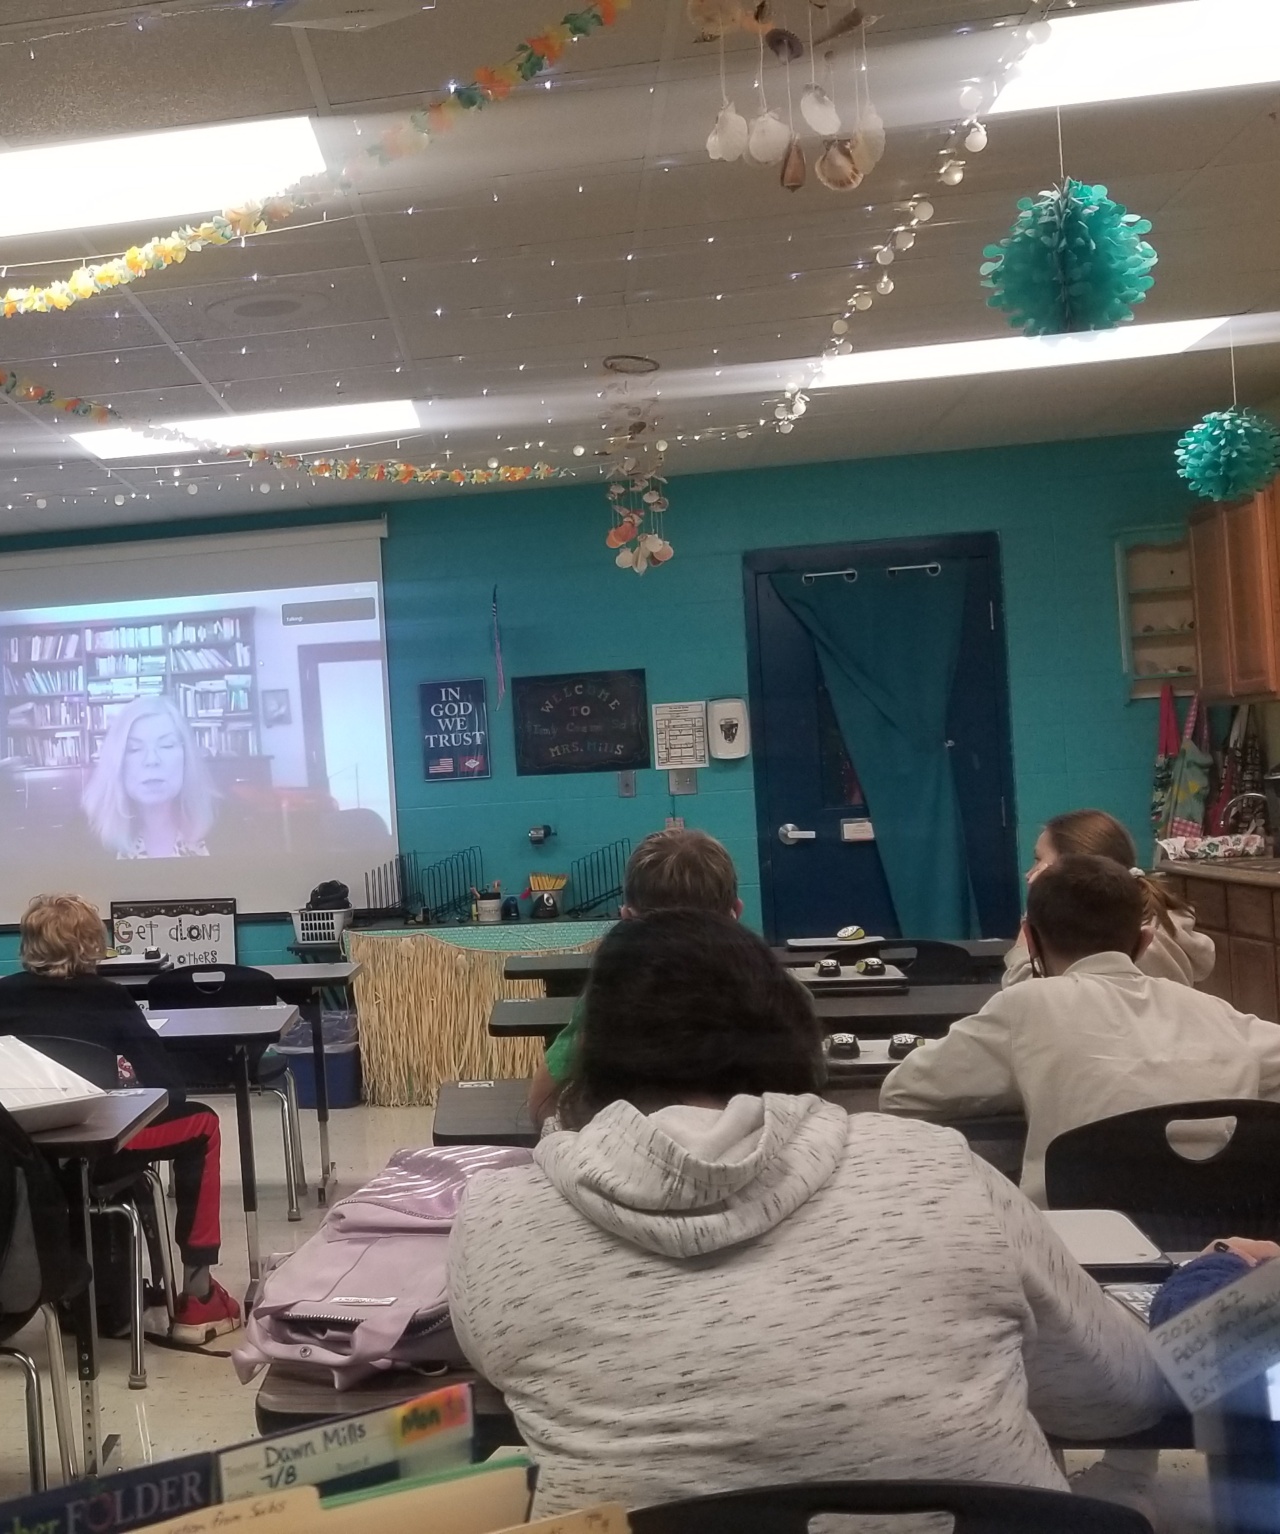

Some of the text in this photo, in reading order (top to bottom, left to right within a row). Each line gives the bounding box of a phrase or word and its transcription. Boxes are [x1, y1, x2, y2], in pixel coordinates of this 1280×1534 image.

[440, 687, 460, 701] IN
[540, 684, 621, 714] WELCOME
[430, 702, 473, 717] GOD
[569, 705, 591, 717] TO
[438, 717, 467, 731] WE
[424, 731, 485, 748] TRUST
[264, 1421, 367, 1469] Dawn Mills
[260, 1465, 298, 1489] 7/8
[66, 1470, 204, 1534] FOLDER
